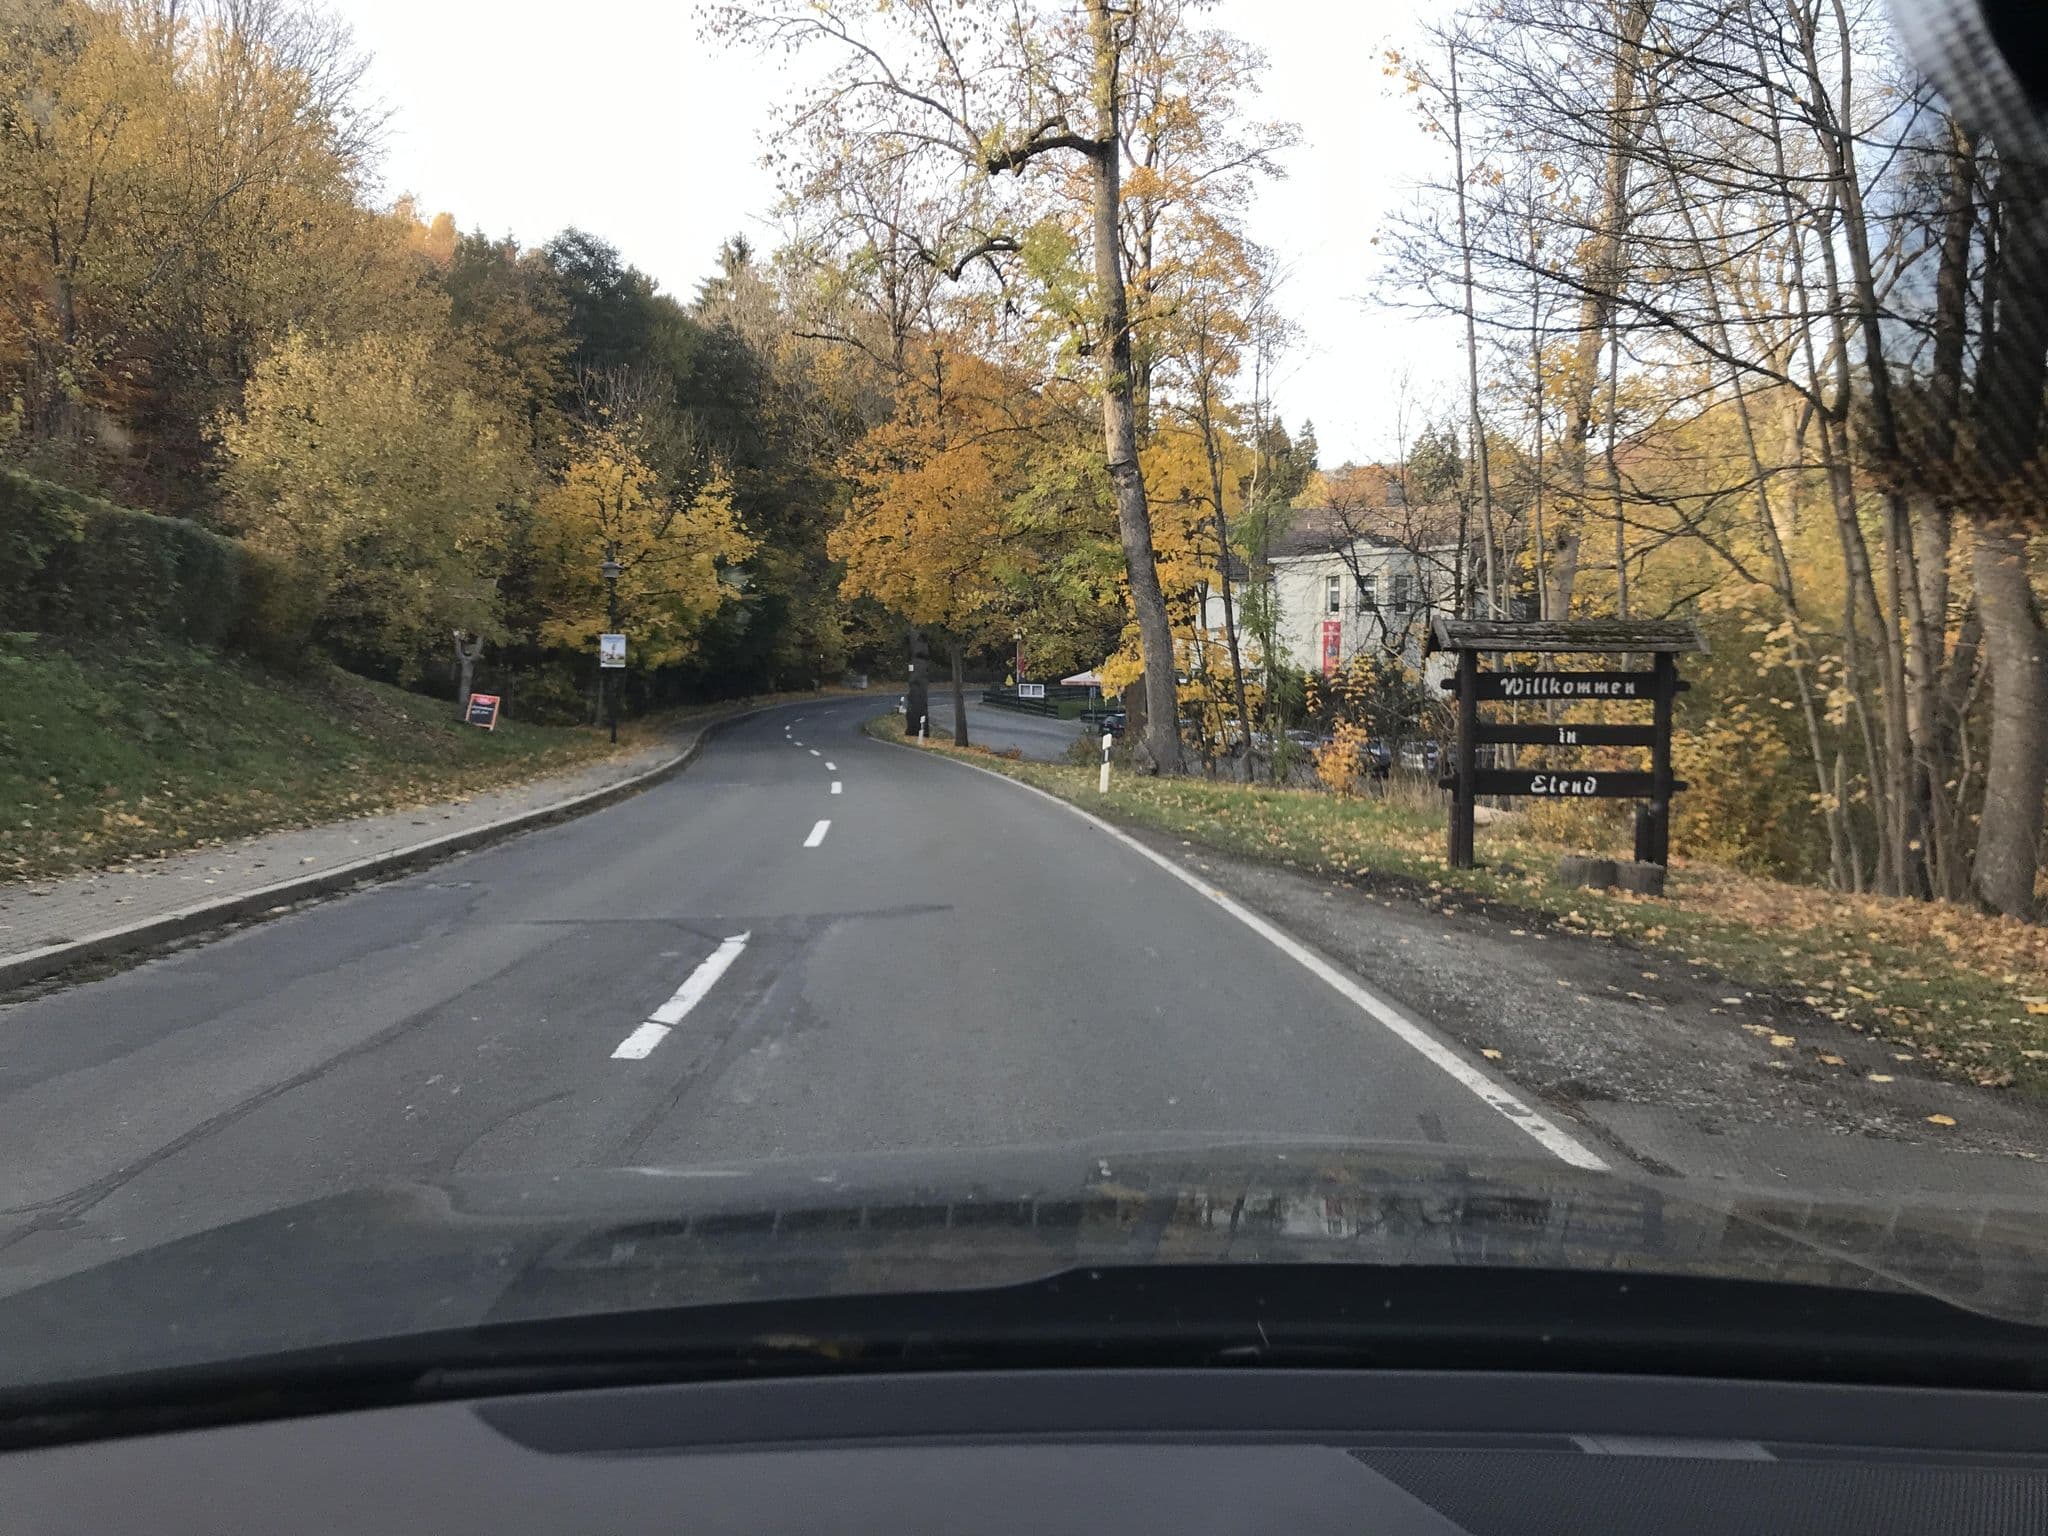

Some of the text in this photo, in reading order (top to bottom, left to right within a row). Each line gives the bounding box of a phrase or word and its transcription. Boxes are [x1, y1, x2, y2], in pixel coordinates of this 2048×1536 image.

[1500, 677, 1636, 696] Willkommen
[1559, 727, 1577, 744] in
[1530, 775, 1598, 794] Elend
